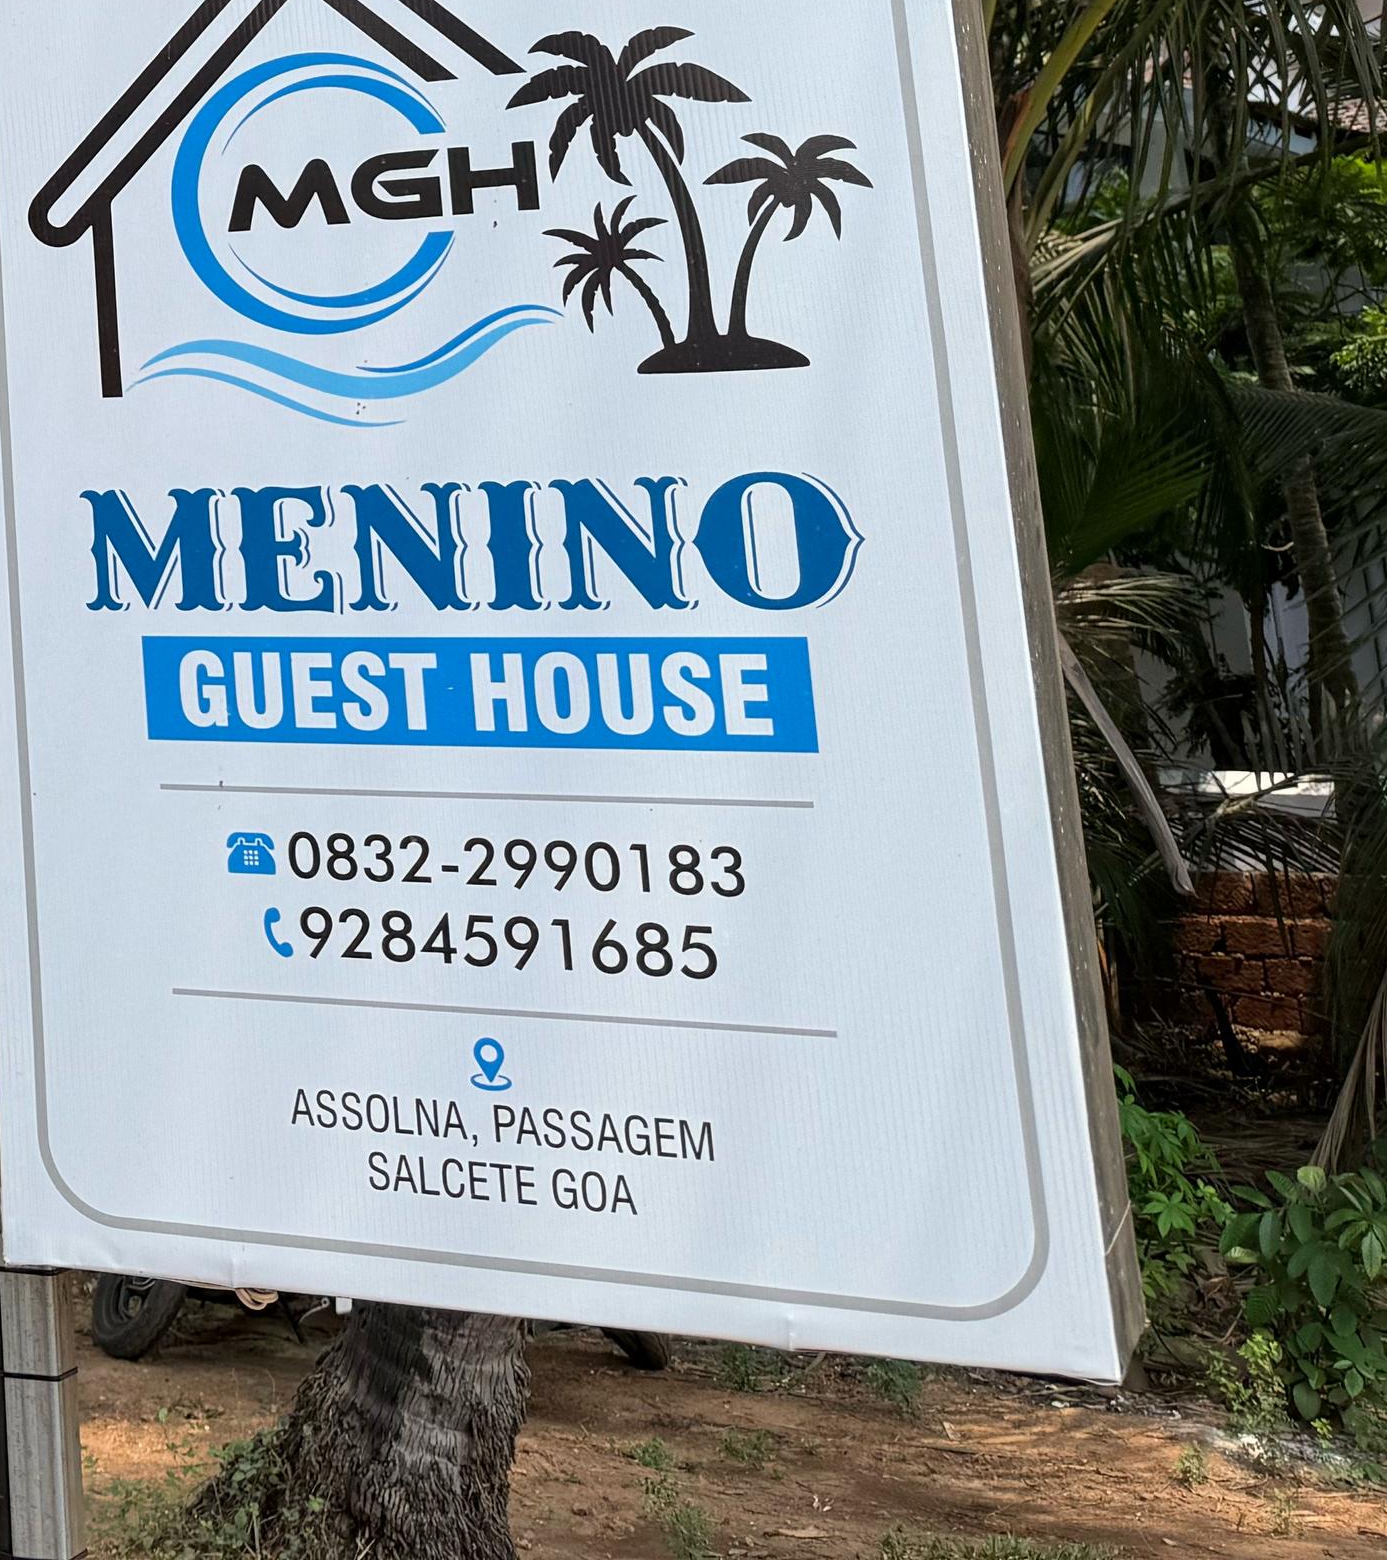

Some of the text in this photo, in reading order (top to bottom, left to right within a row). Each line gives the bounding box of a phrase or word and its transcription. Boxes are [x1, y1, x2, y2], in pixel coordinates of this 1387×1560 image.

[227, 140, 540, 233] MGH
[80, 471, 866, 615] MENINO
[179, 650, 774, 736] GUEST HOUSE
[288, 831, 746, 898] 0832-2990183
[299, 906, 718, 980] 9284591685
[291, 1088, 715, 1162] ASSOLNA, PASSAGEM
[368, 1151, 638, 1215] SALCETE GOA
